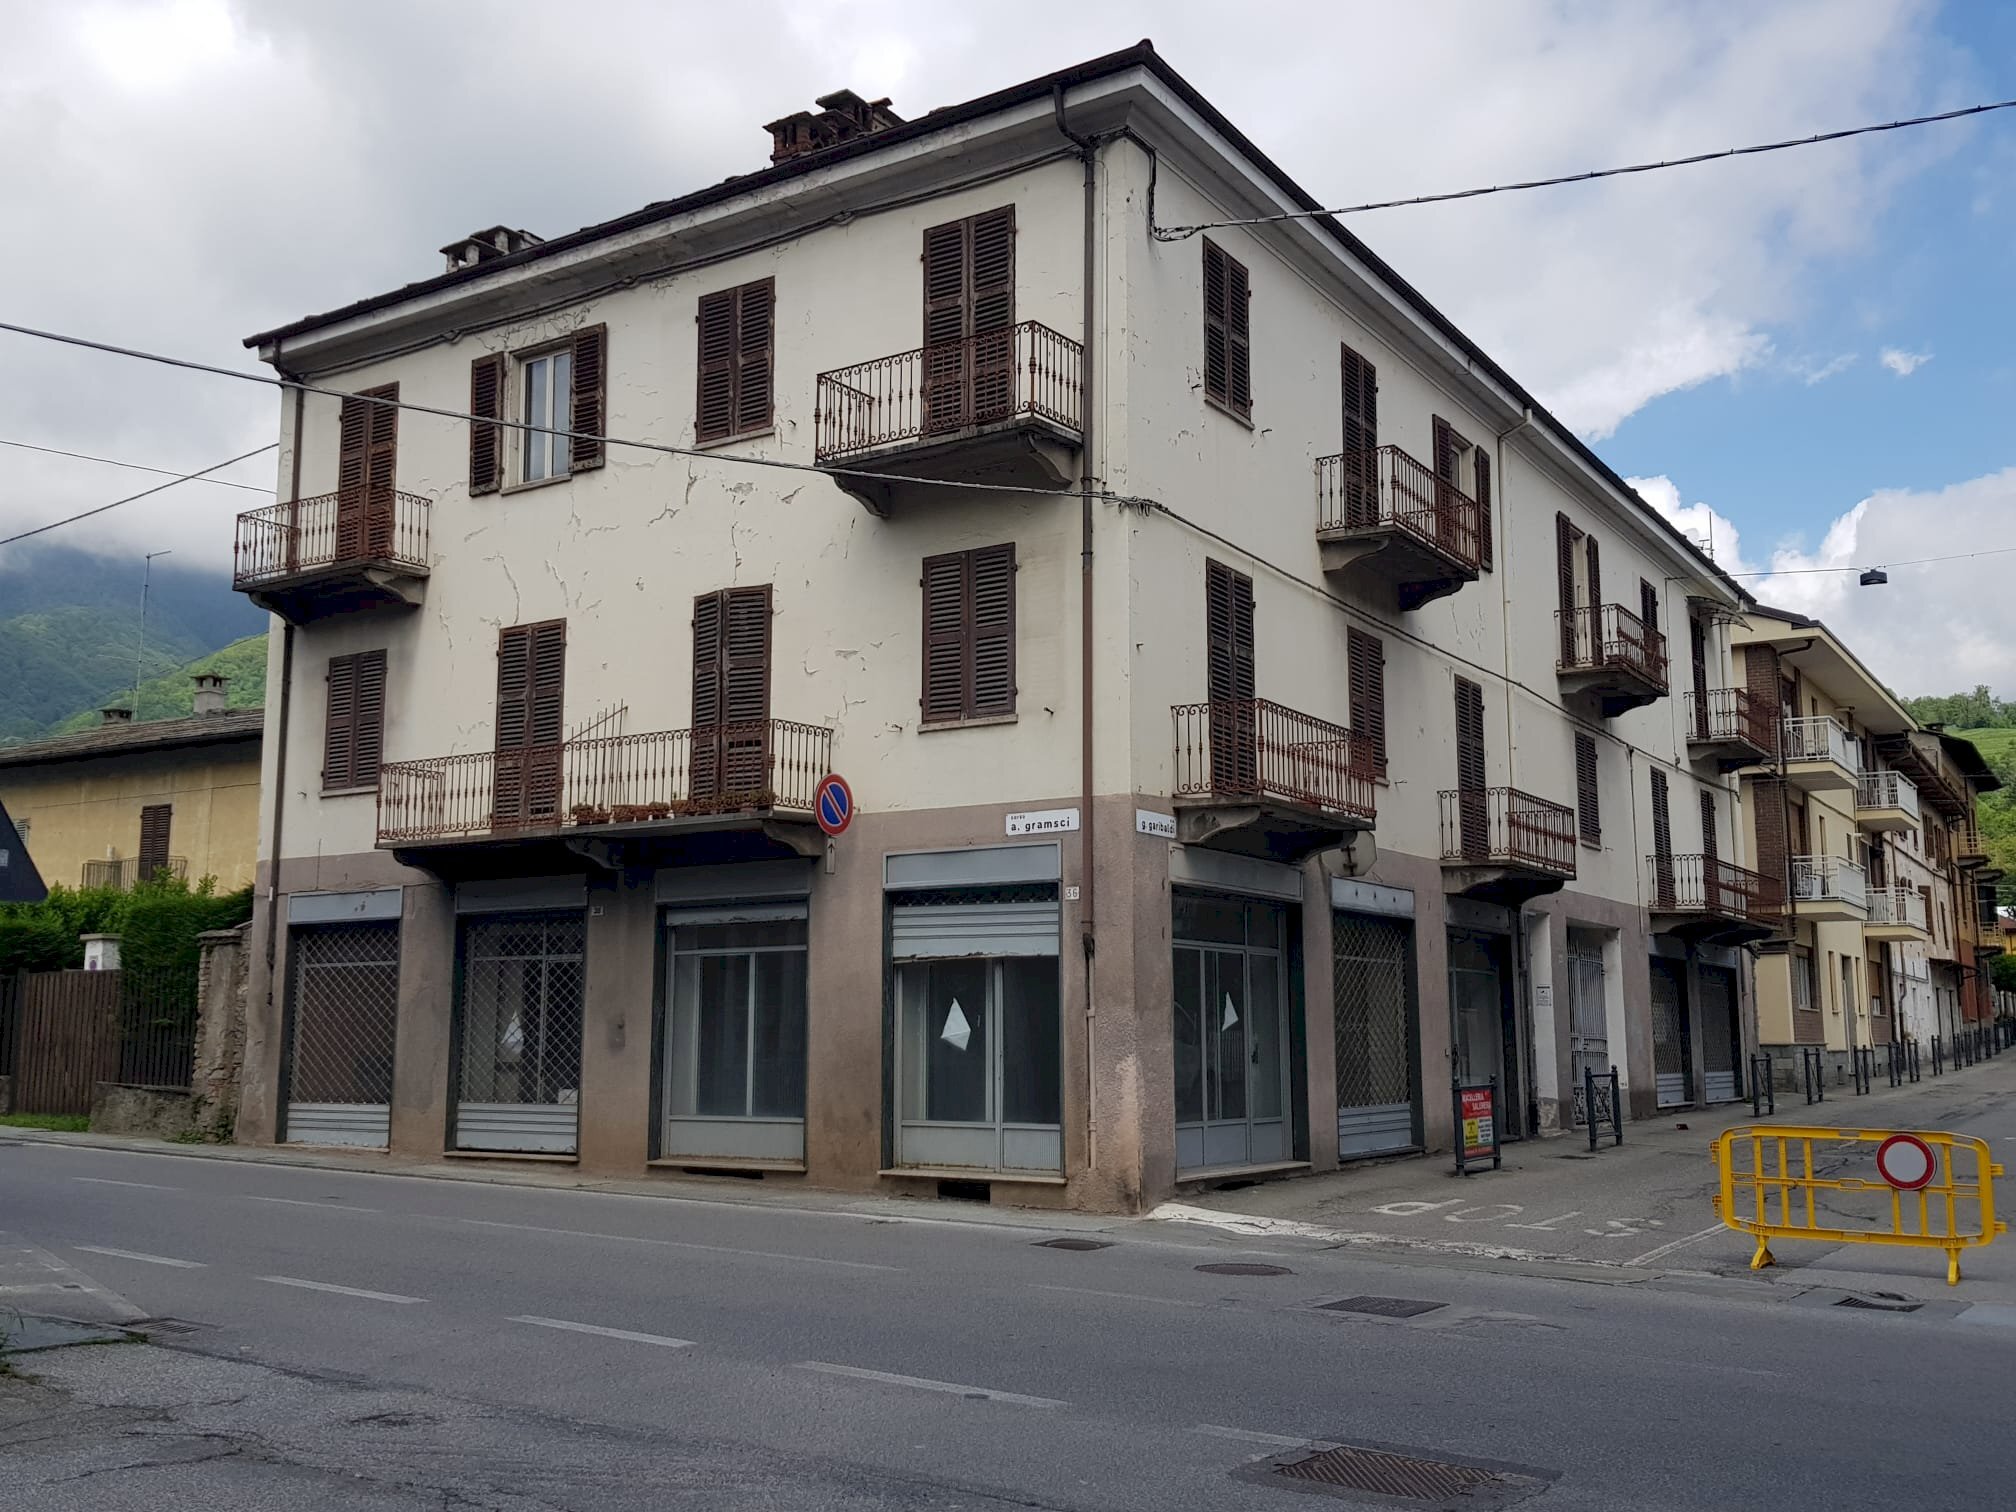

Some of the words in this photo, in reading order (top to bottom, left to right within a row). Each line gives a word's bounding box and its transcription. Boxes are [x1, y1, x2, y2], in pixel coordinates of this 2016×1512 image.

[1011, 823, 1021, 832] a.
[1025, 816, 1070, 832] gramsci
[1148, 820, 1176, 835] garibaldi
[1065, 887, 1078, 898] 36
[1368, 1198, 1665, 1238] STOP
